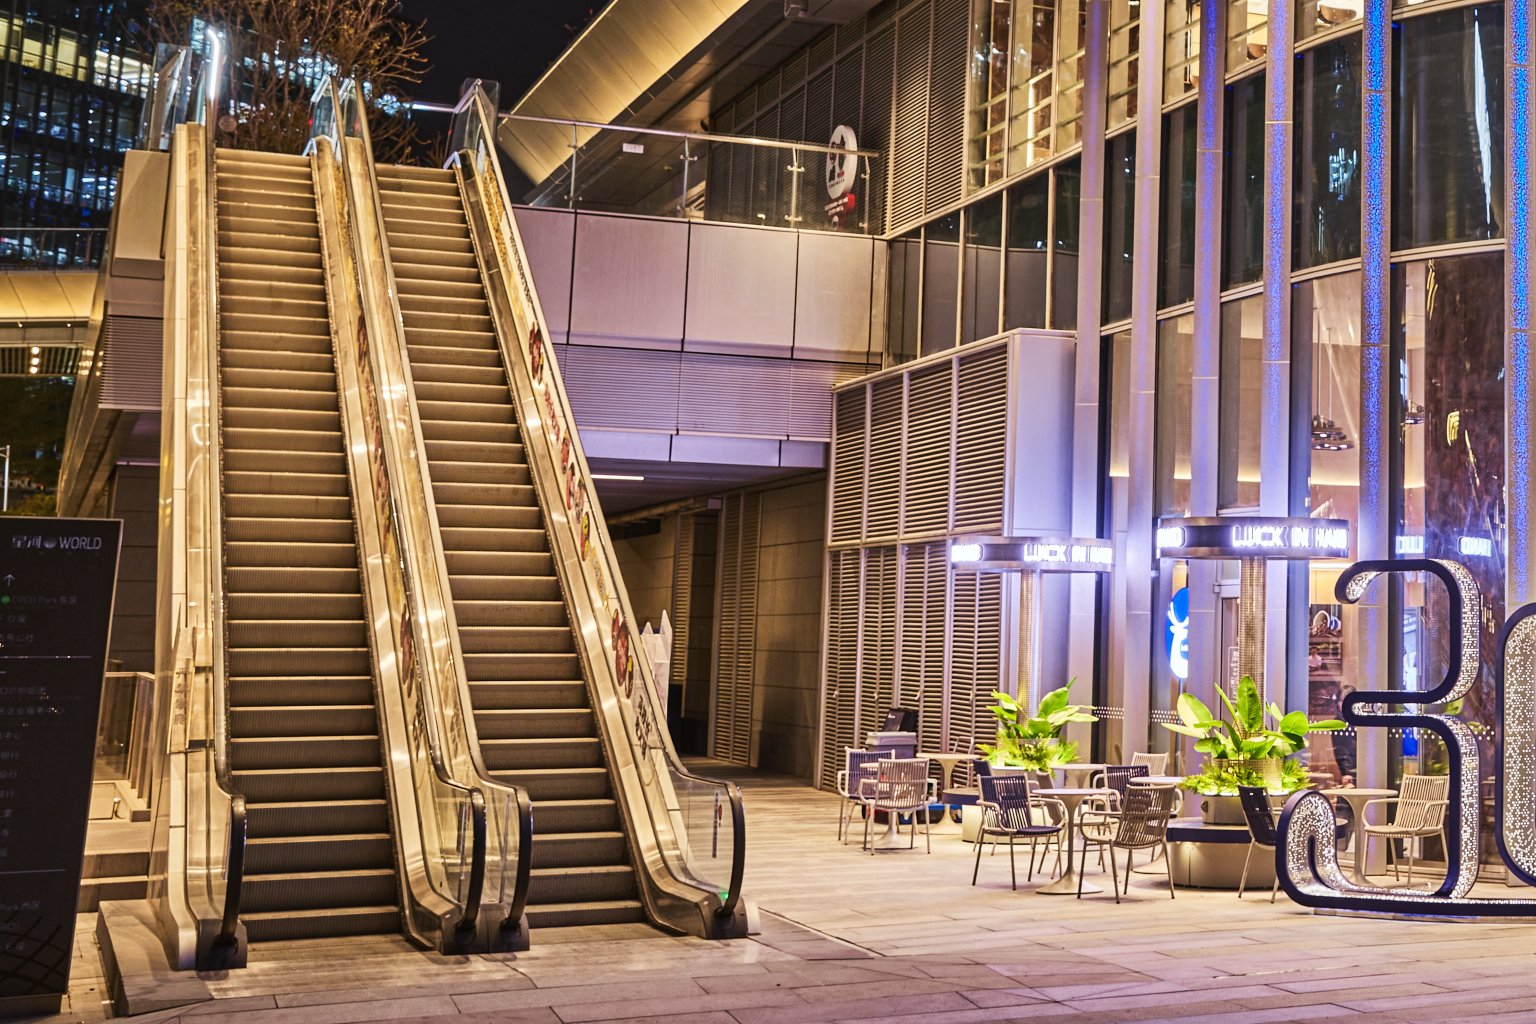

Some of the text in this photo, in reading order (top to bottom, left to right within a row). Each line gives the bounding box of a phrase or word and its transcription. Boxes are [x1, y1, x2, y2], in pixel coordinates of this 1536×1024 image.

[59, 536, 102, 550] WORLD
[1232, 526, 1289, 549] LUCK
[1292, 526, 1313, 549] IN
